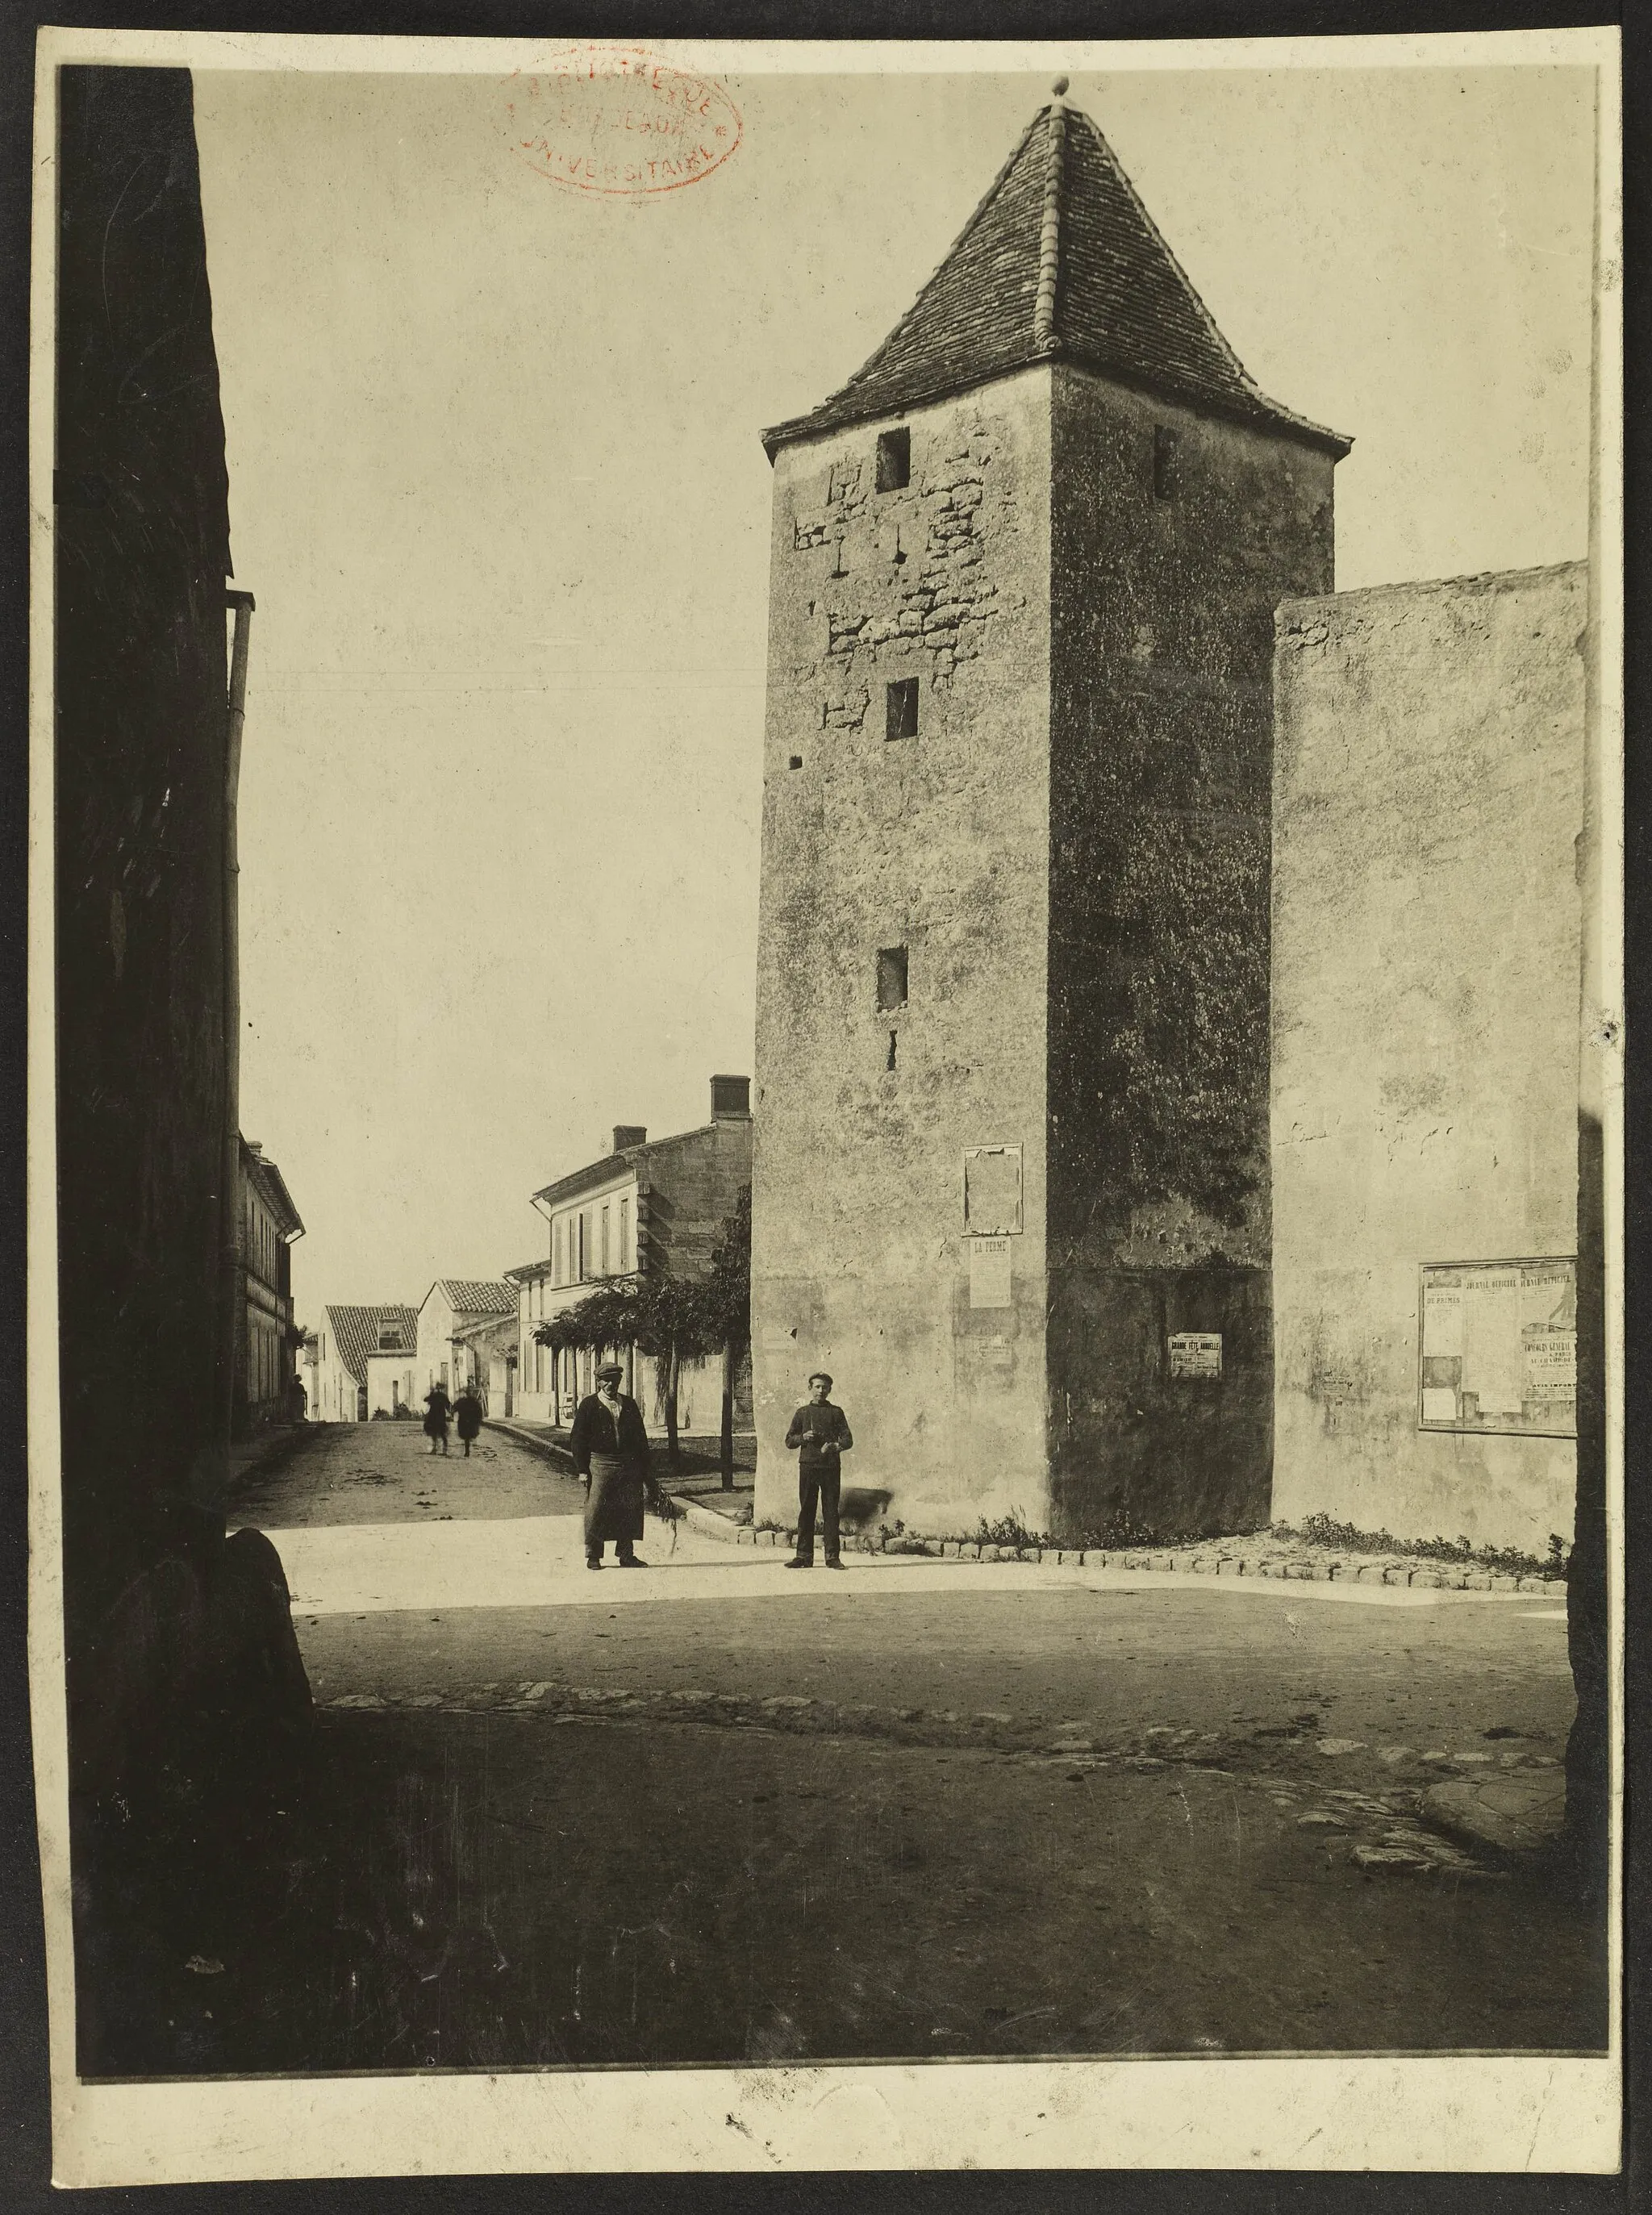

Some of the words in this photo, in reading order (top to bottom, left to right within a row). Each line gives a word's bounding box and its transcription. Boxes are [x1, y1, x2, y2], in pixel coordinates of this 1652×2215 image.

[974, 1241, 982, 1253] LA
[986, 1240, 1007, 1252] FERME
[1466, 1281, 1489, 1289] JOURNAL
[1491, 1279, 1516, 1288] OFFICIEL
[1172, 1341, 1187, 1349] GRANDE
[1200, 1342, 1220, 1350] ANNUELLE
